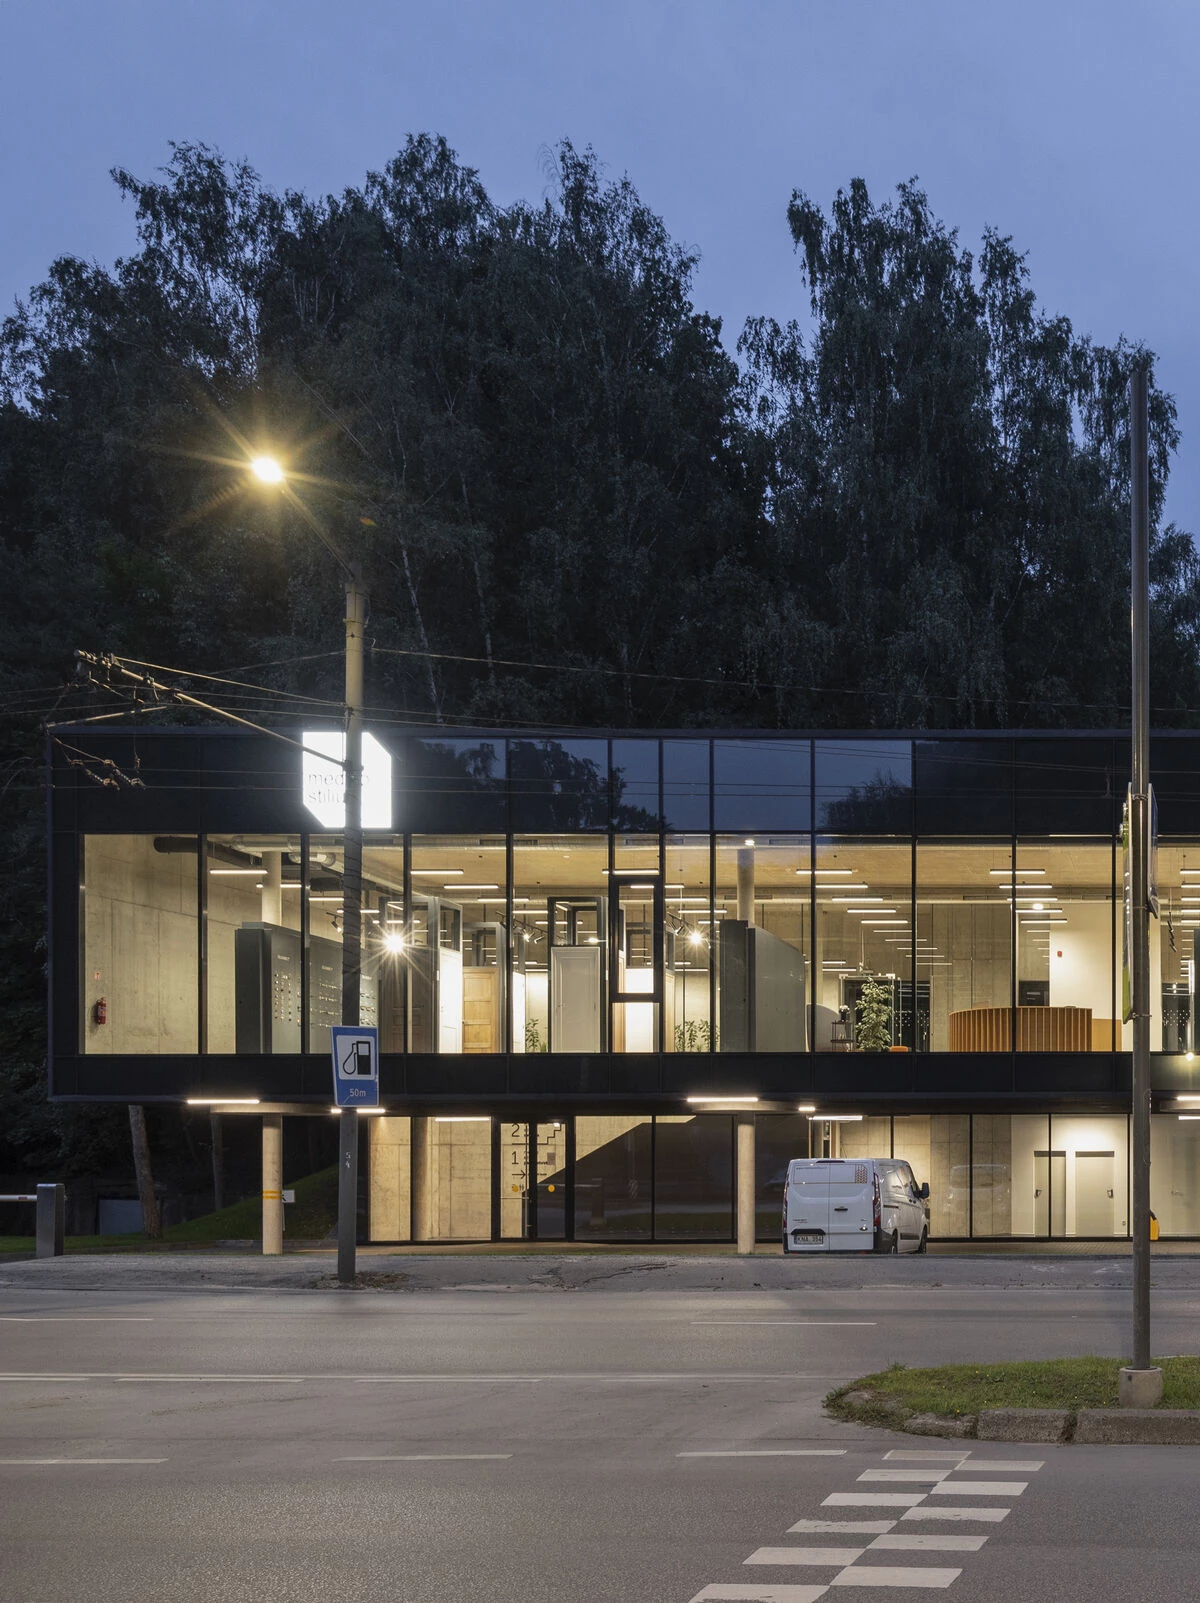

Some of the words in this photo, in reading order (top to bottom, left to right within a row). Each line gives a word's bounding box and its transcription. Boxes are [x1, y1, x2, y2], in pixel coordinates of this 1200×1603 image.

[349, 1088, 366, 1097] 50m
[511, 1123, 520, 1137] 2
[511, 1150, 519, 1165] 1
